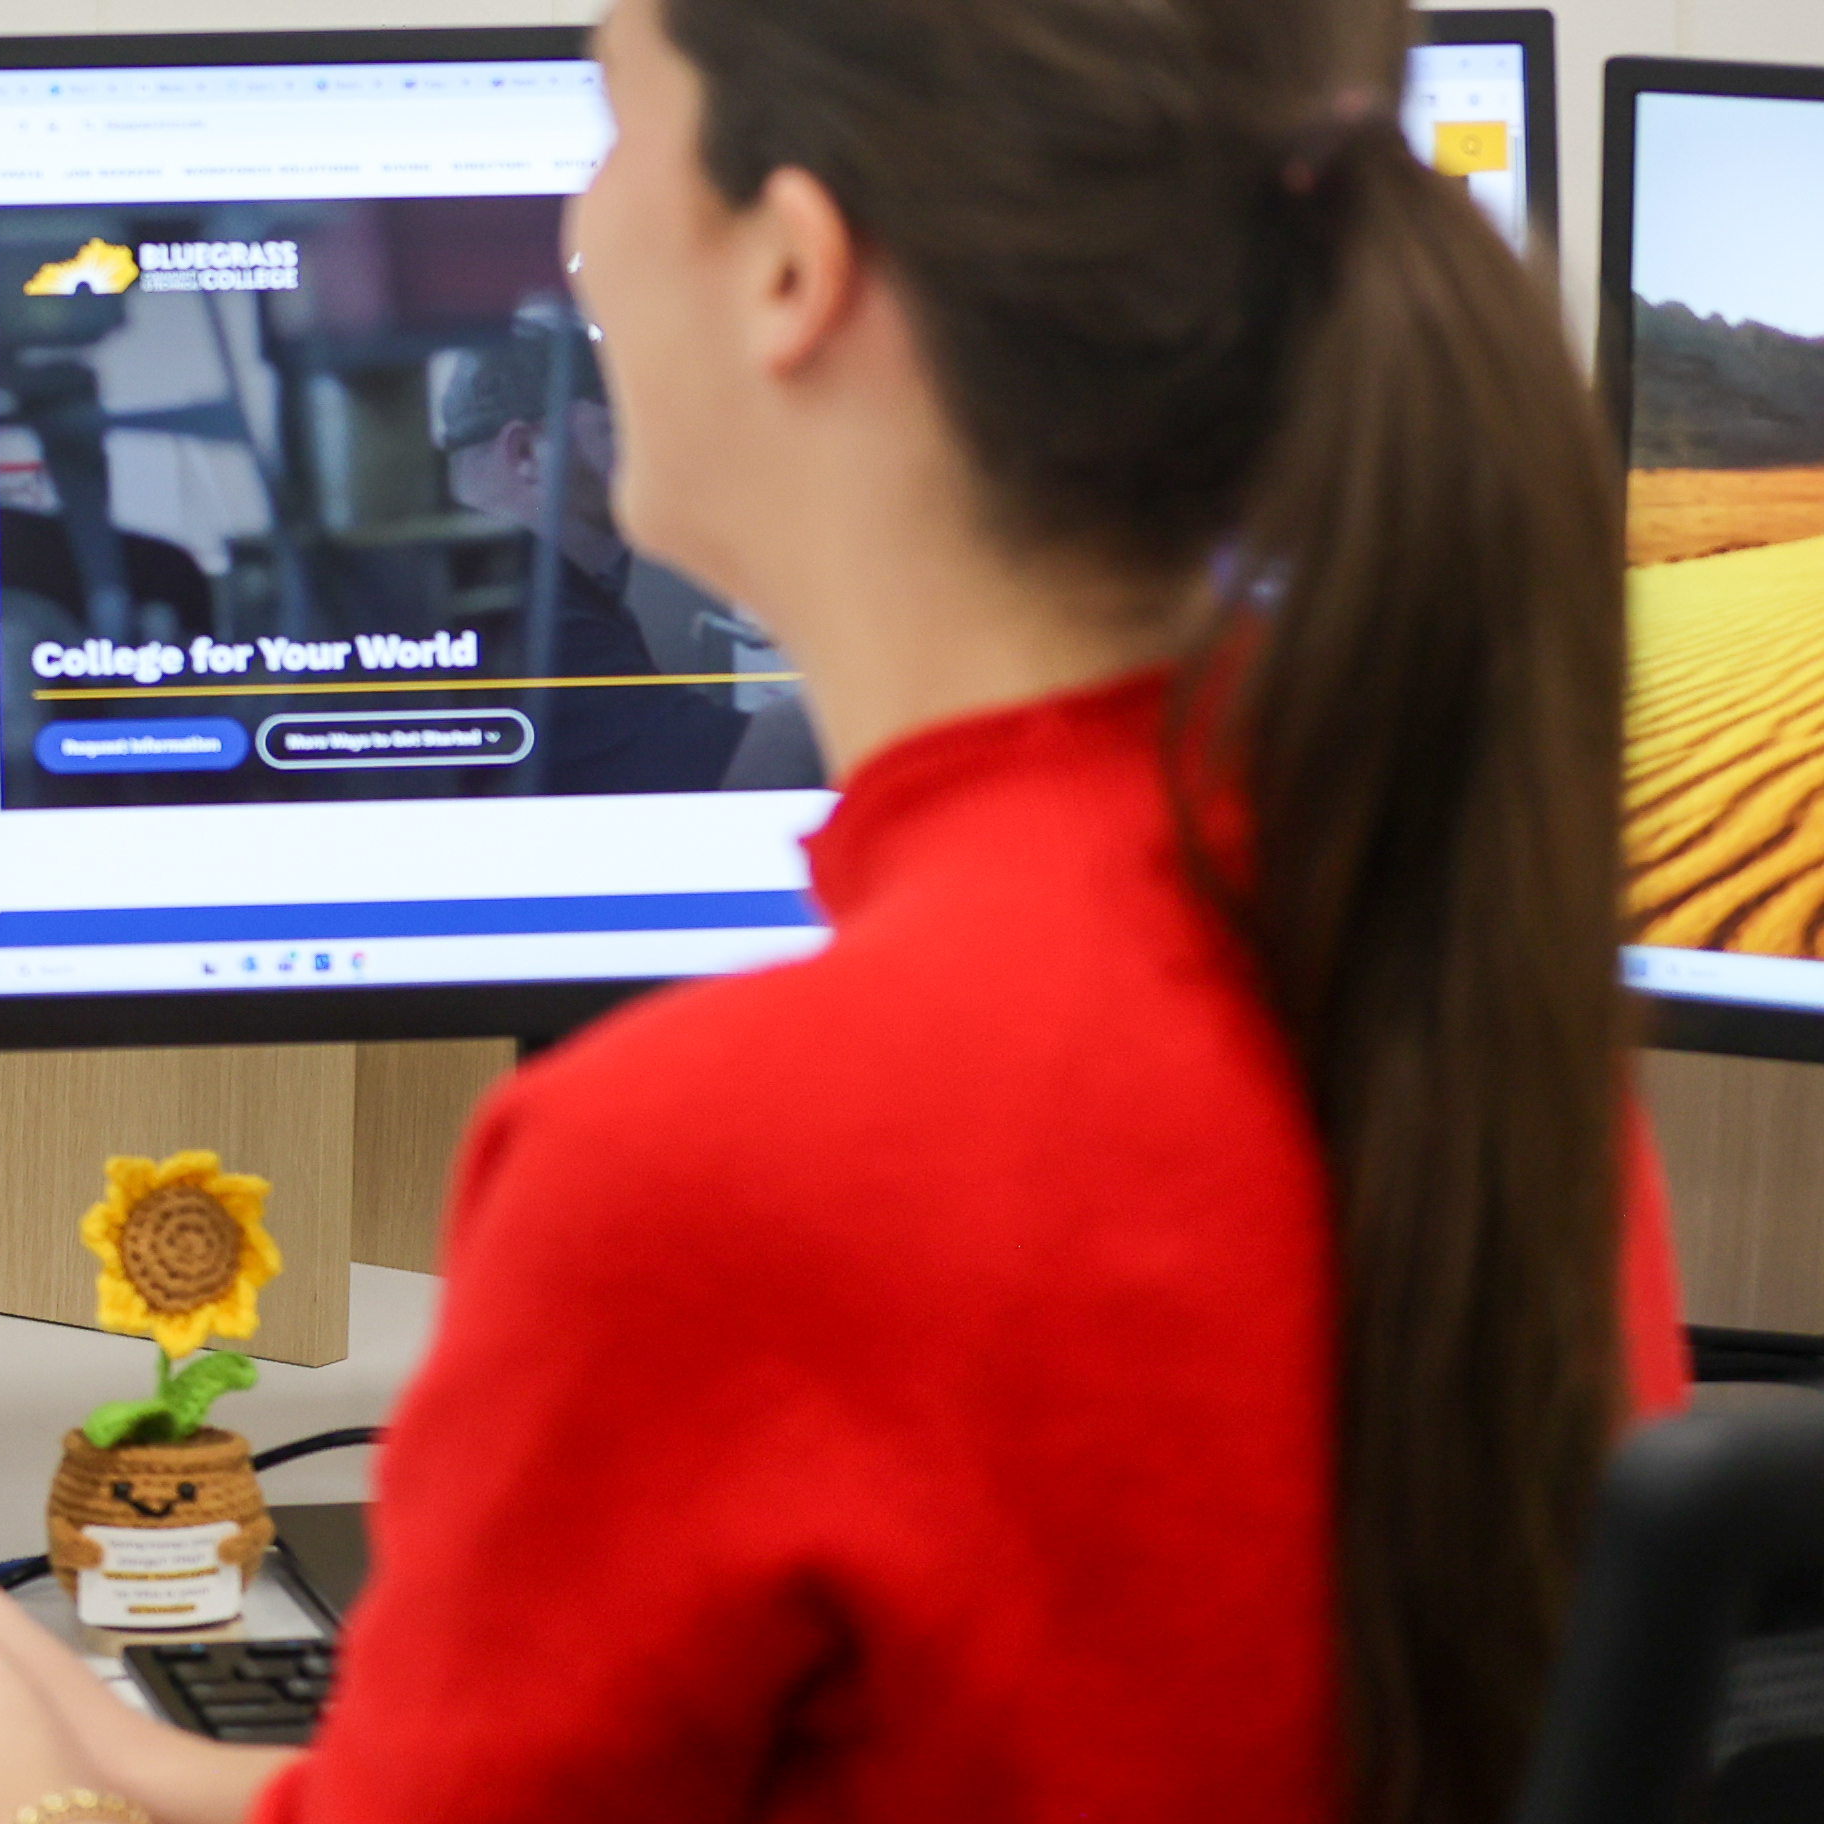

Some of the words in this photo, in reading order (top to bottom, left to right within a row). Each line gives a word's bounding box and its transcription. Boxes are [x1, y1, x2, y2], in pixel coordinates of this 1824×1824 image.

[138, 240, 299, 271] BLUEGRASS
[198, 267, 299, 291] COLLEGE
[32, 639, 185, 684] College
[189, 635, 252, 674] for
[255, 636, 352, 672] Your
[354, 629, 479, 670] World
[60, 737, 128, 759] Request
[128, 734, 222, 755] Information
[284, 732, 328, 751] More
[327, 731, 371, 753] Ways
[420, 727, 483, 748] Started
